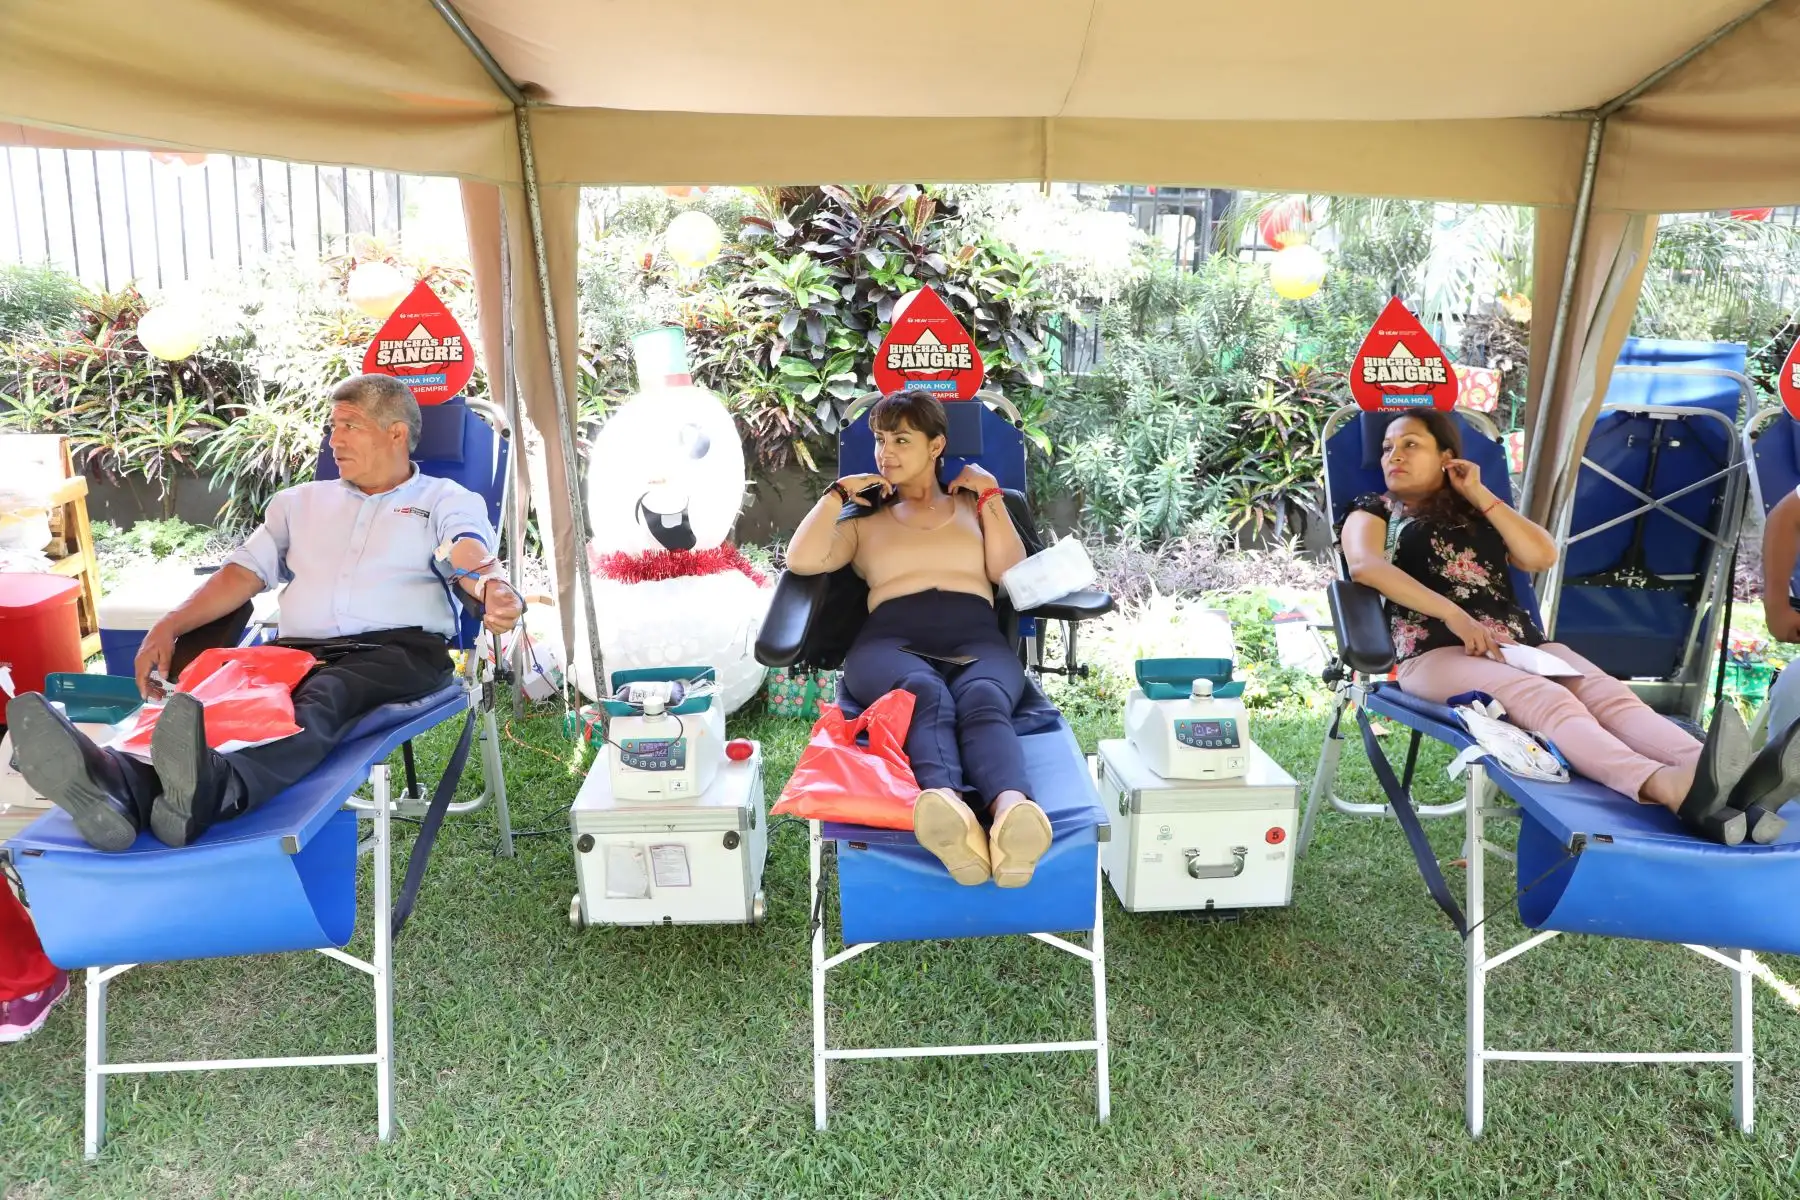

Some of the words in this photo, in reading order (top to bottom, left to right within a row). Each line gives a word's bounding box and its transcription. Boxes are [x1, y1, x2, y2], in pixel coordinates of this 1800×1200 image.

[379, 337, 439, 350] HINCHAS
[443, 336, 461, 346] DE
[889, 344, 948, 354] HINCHAS
[951, 344, 969, 353] DE
[377, 346, 463, 366] SANGRE
[887, 353, 972, 369] SANGRE
[1363, 357, 1421, 366] HINCHAS
[1424, 357, 1443, 367] DE
[1363, 366, 1447, 383] SANGRE
[1386, 523, 1398, 547] MINSA
[1272, 831, 1279, 840] 5
